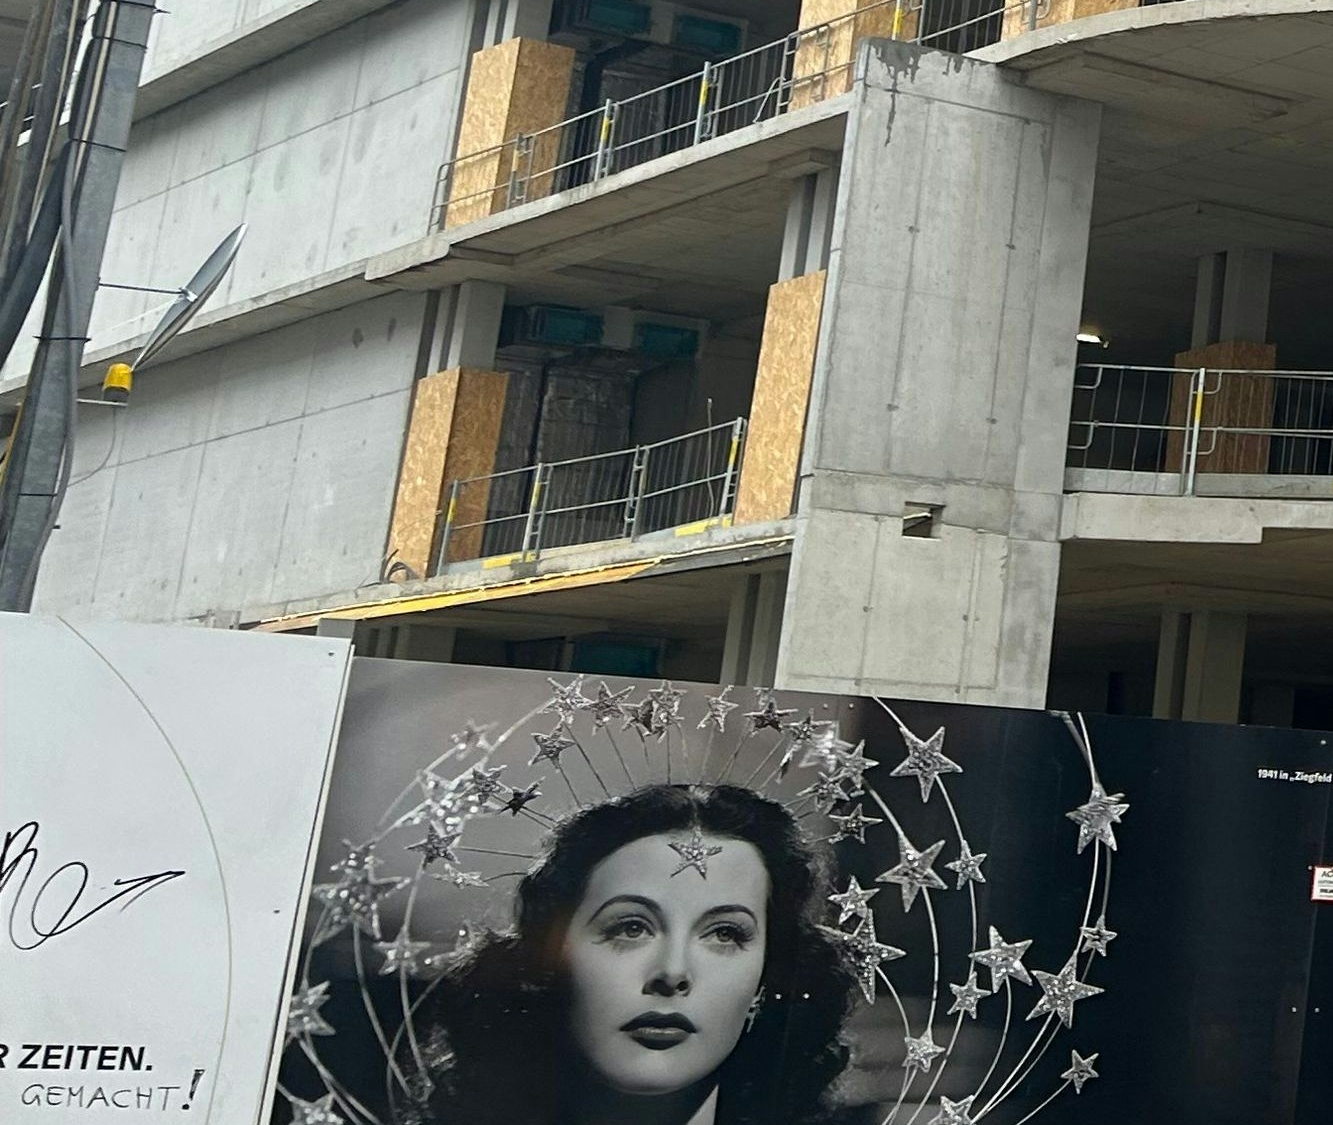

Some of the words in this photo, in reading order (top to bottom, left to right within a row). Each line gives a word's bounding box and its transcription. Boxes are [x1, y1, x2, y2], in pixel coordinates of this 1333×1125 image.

[1258, 768, 1278, 779] 1941
[1279, 770, 1289, 780] in
[17, 1043, 153, 1071] ZEITEN.
